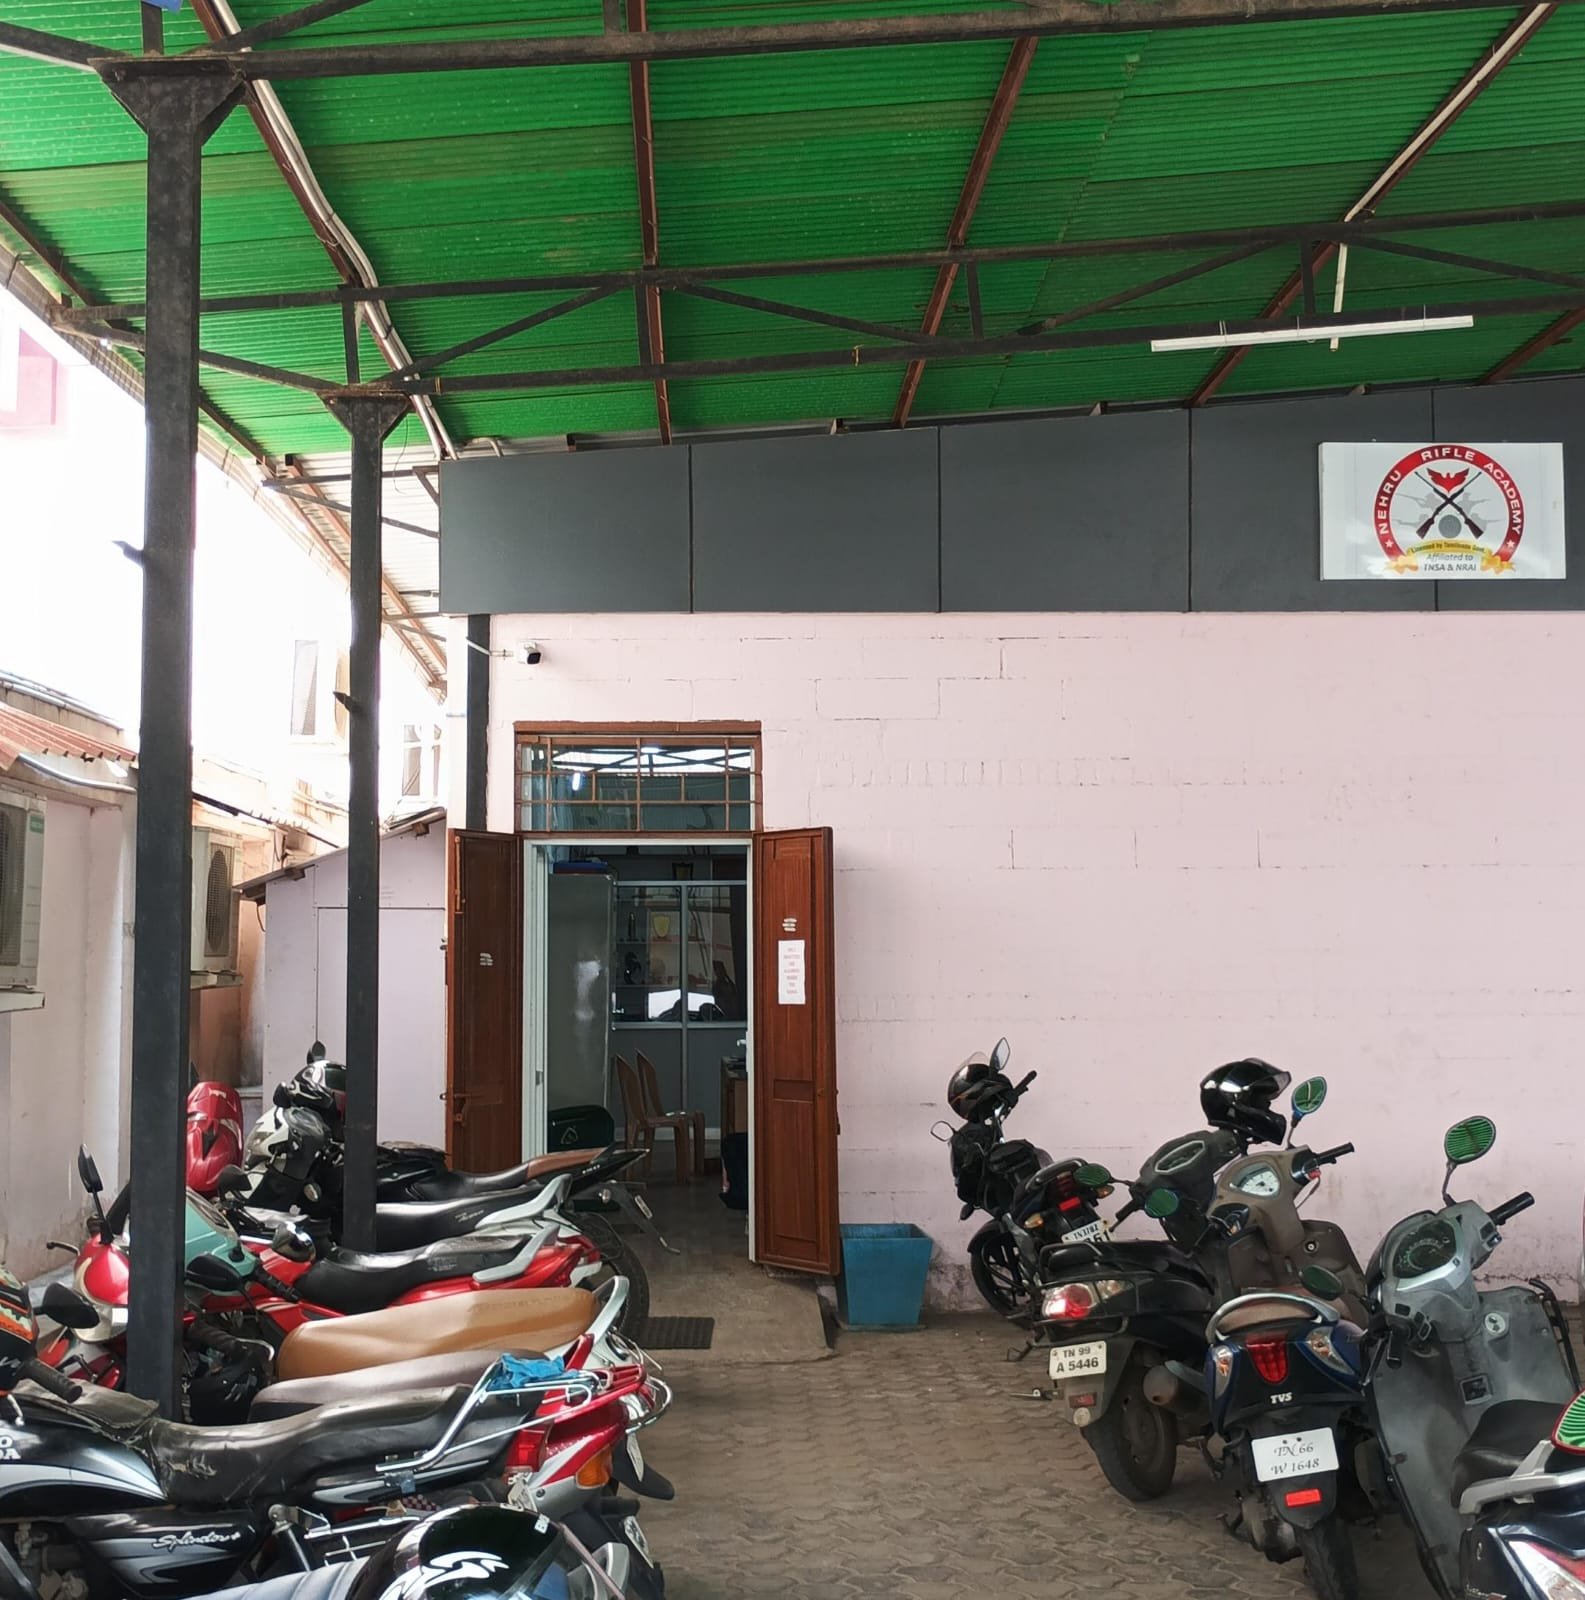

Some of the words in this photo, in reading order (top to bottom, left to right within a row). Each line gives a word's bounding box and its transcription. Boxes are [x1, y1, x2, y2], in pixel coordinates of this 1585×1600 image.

[1377, 469, 1401, 535] NEHRU
[1420, 447, 1476, 461] RIFLE
[1483, 462, 1522, 535] ACADEMY
[1062, 1349, 1076, 1358] TN
[1078, 1346, 1091, 1356] 99
[1056, 1362, 1065, 1373] A
[1068, 1357, 1099, 1371] 5446
[1270, 1392, 1293, 1404] TVS
[1273, 1444, 1299, 1457] TN
[1299, 1442, 1314, 1454] 66
[1291, 1458, 1320, 1472] 1648
